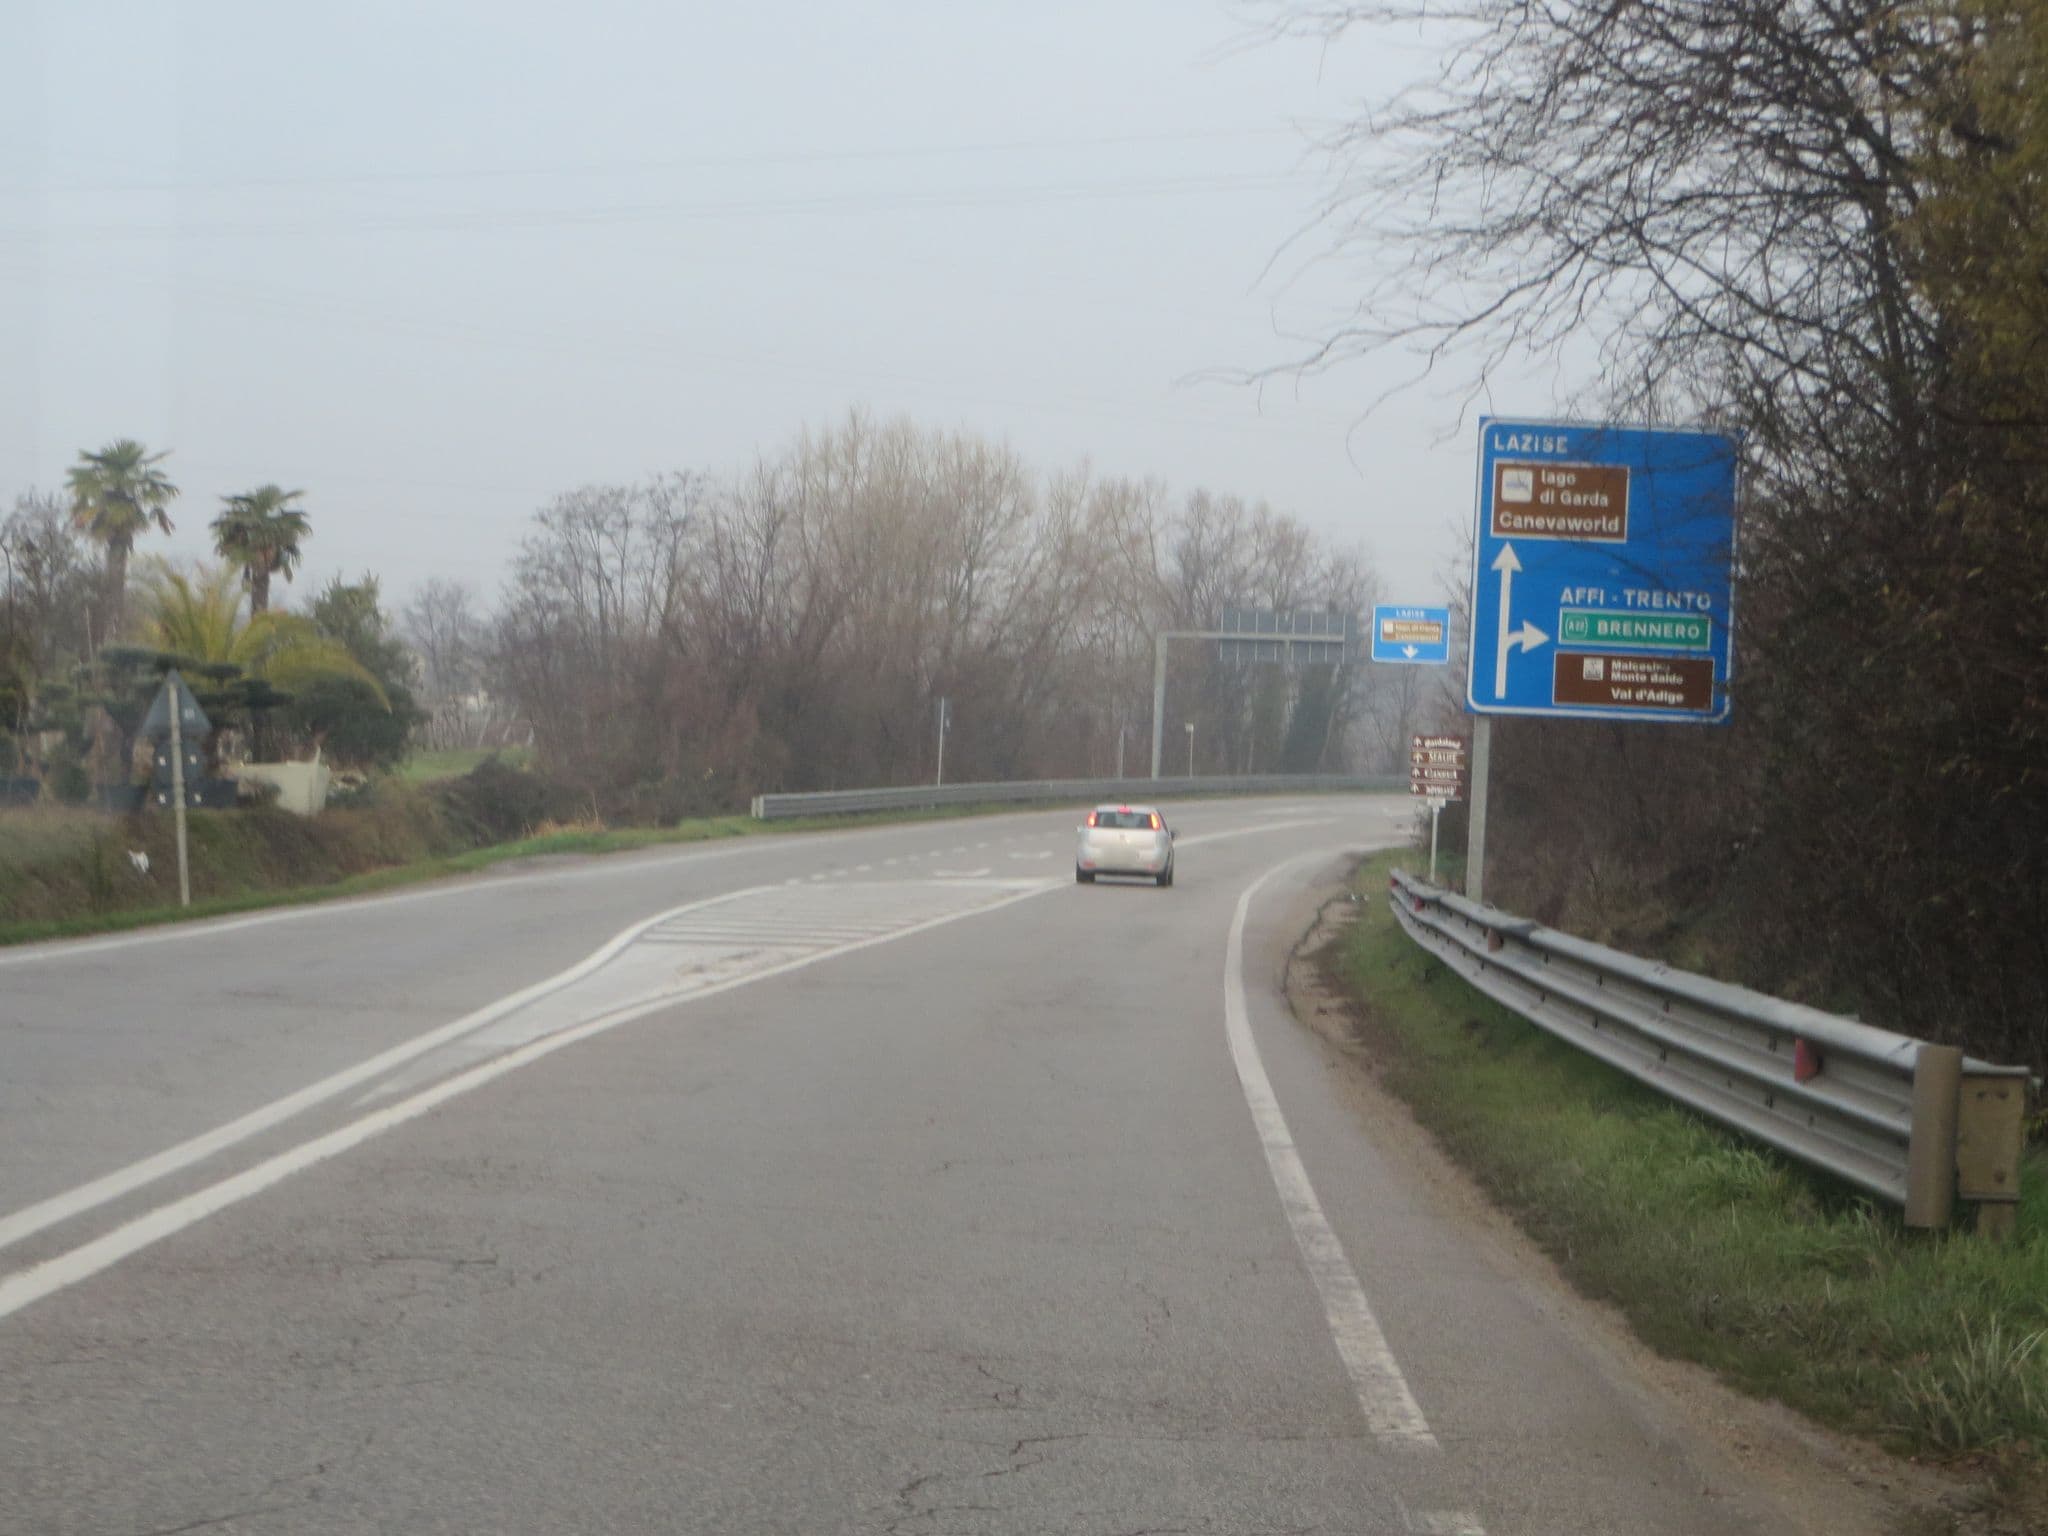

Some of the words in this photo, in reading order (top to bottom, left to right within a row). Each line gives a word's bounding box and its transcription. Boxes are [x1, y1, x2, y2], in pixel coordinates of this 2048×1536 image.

[1494, 432, 1568, 454] LAZISE
[1540, 468, 1577, 488] lago
[1540, 489, 1554, 504] di
[1560, 490, 1609, 507] Garda
[1499, 511, 1619, 532] Canevaworld
[1560, 587, 1604, 605] AFFI
[1623, 588, 1711, 610] TRENTO
[1597, 619, 1700, 640] BRENNERO
[1611, 687, 1632, 699] Val
